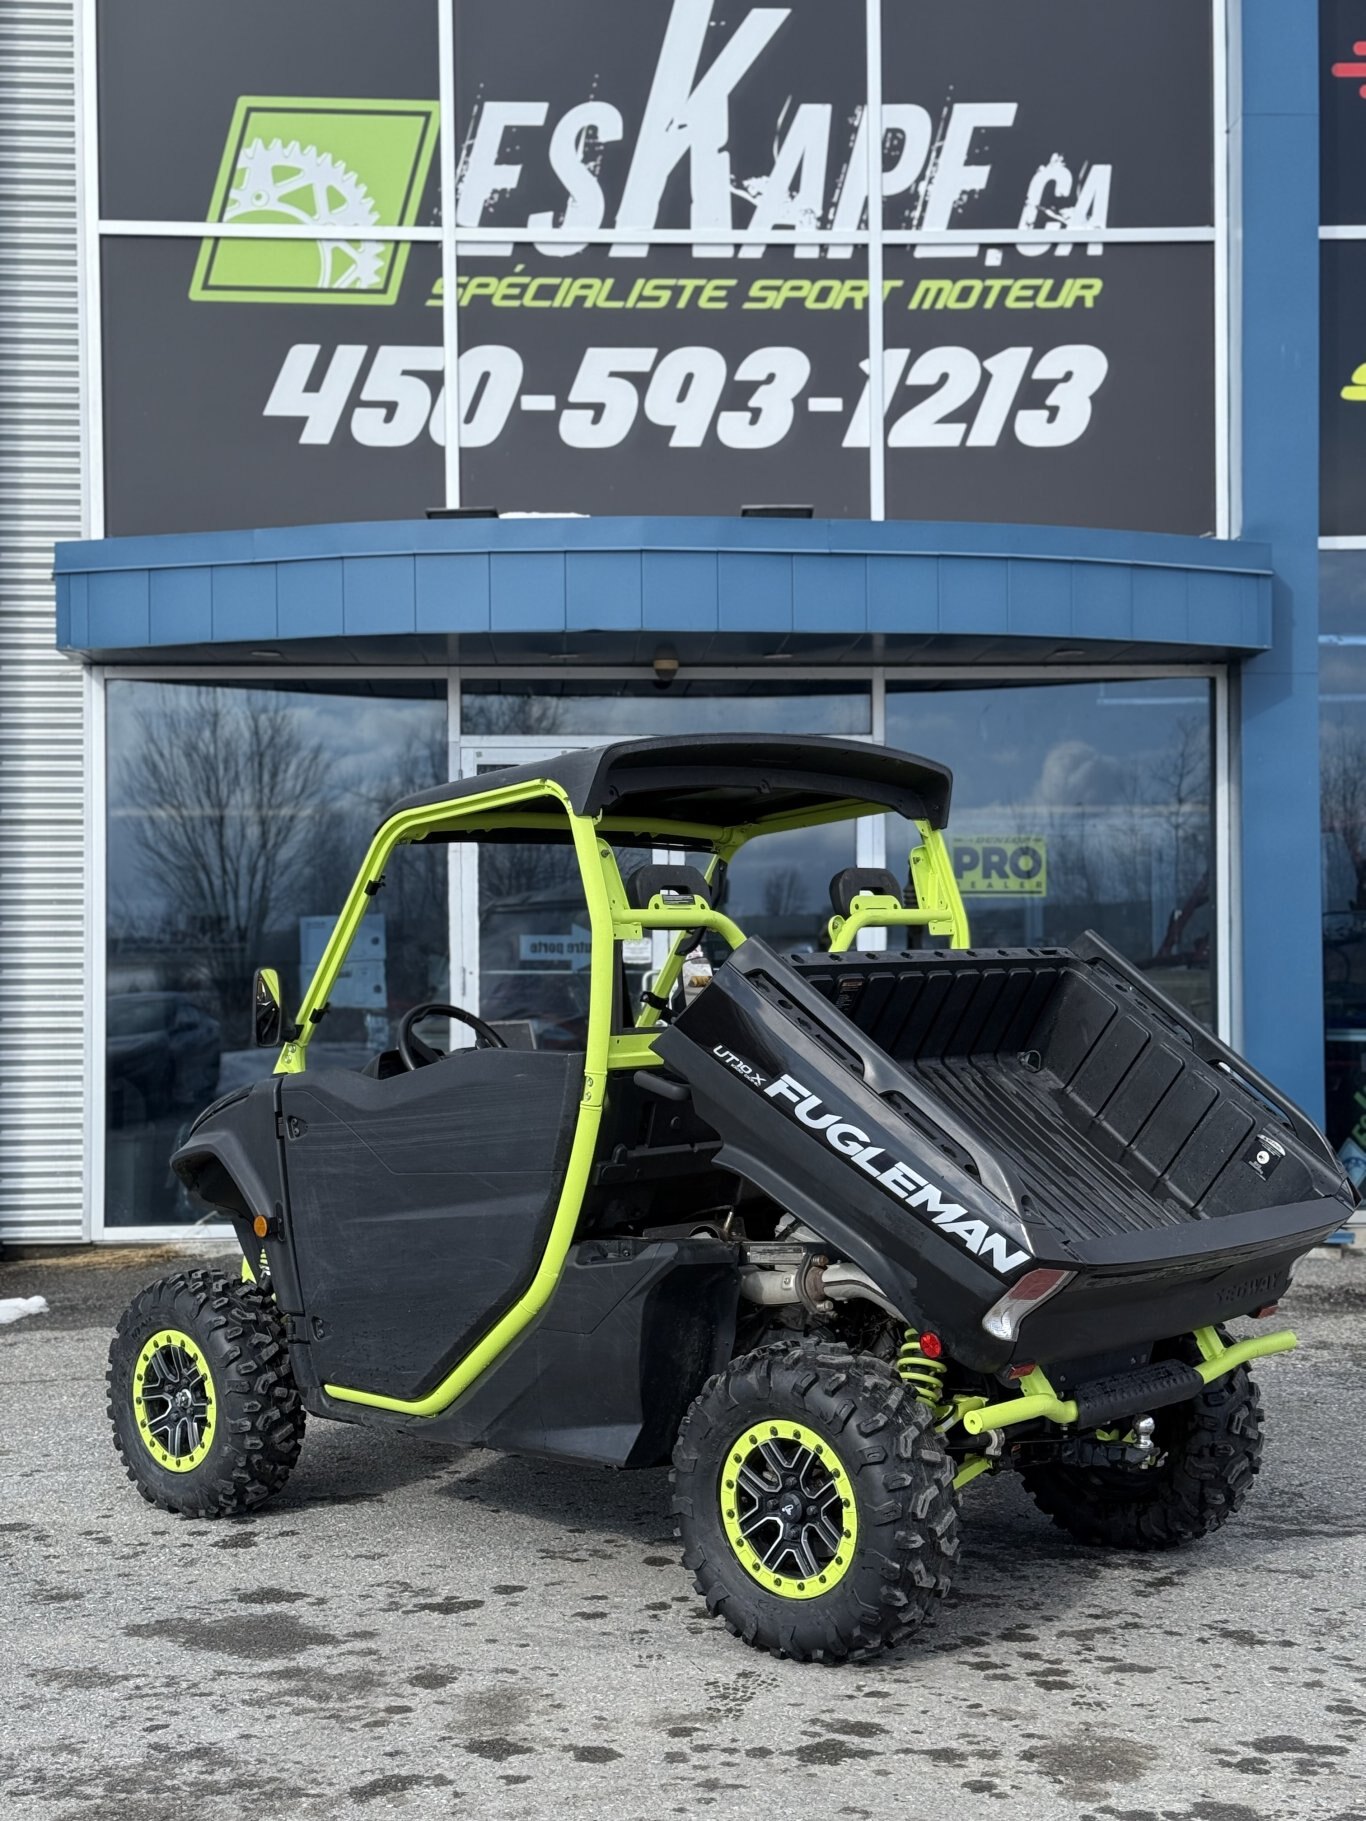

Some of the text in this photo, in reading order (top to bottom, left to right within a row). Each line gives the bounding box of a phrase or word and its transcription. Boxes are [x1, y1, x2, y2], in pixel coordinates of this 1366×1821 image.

[425, 264, 1103, 310] SPÉCIALISTE SPORT MOTEUR
[262, 343, 1109, 449] 450-593-1213
[953, 846, 1042, 879] PRO
[958, 881, 1042, 889] EALER
[764, 1074, 1031, 1273] FUGLEMAN
